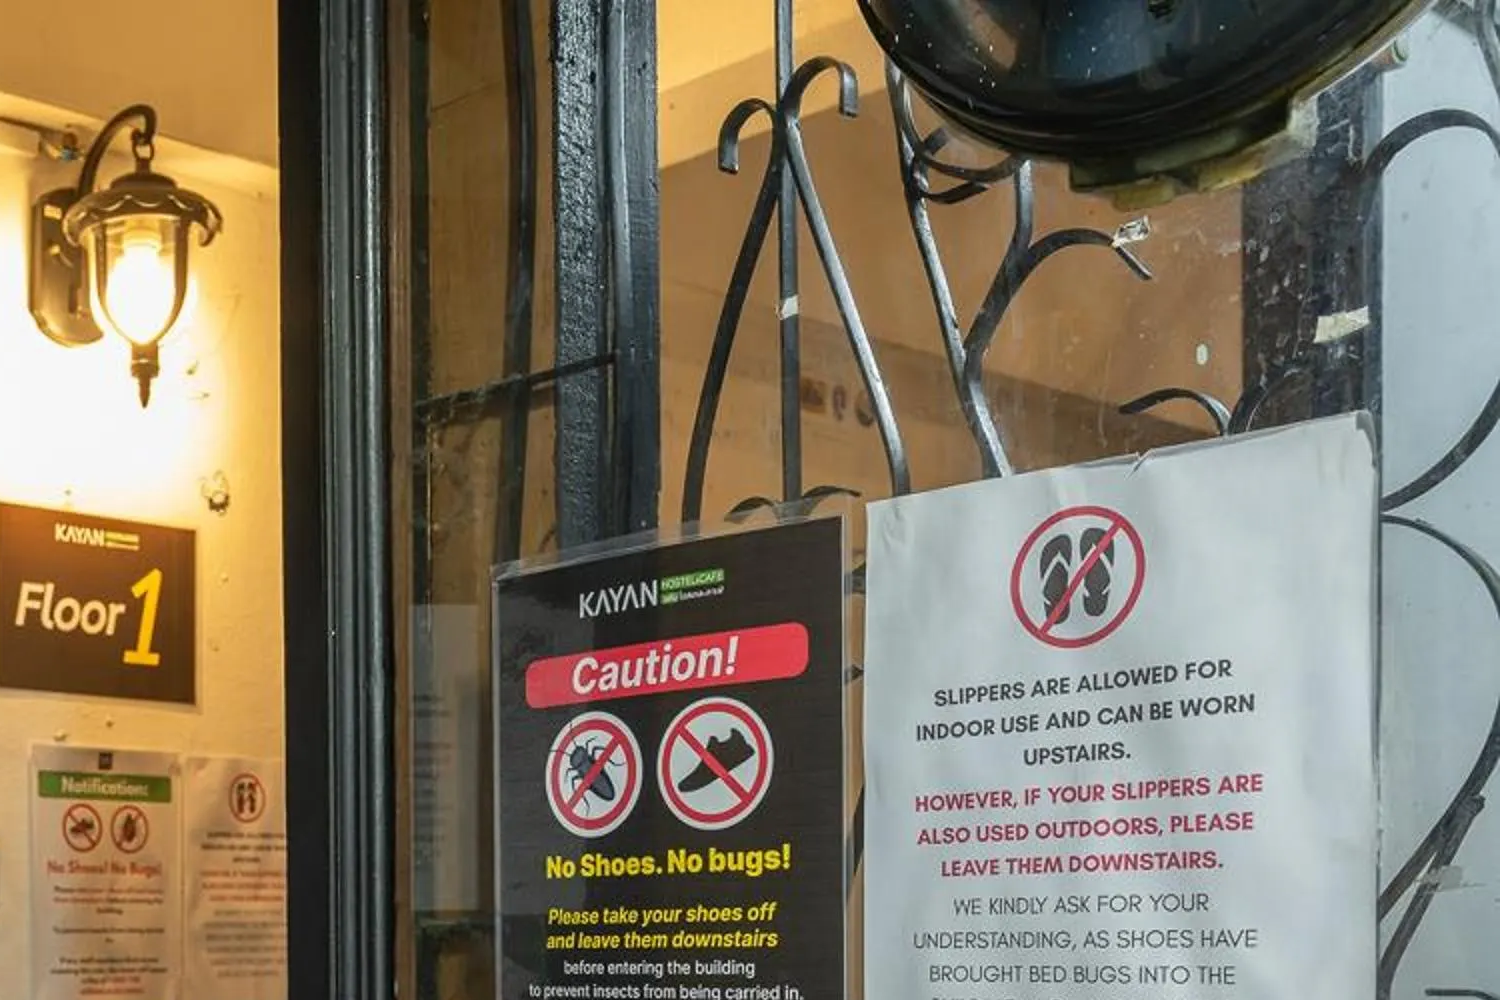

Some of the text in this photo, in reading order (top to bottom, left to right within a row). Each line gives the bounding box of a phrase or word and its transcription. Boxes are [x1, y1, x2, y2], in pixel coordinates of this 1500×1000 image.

[55, 523, 105, 547] KAYAN
[579, 580, 658, 618] KAYAN
[15, 568, 163, 666] Floor 1
[572, 636, 739, 695] Caution!
[934, 659, 1232, 707] SLIPPERS ARE ALLOWED FOR
[916, 694, 1255, 741] INDOOR USE AND CAN BE WORN
[1023, 742, 1131, 766] UPSTAIRS.
[915, 774, 1264, 812] HOWEVER, IF YOUR SLIPPERS ARE
[917, 812, 1254, 845] ALSO USED OUTDOORS, PLEASE
[546, 843, 791, 879] No Shoes. No bugs!
[941, 851, 1224, 877] LEAVE THEM DOWNSTAIRS.
[548, 902, 777, 927] Please take your shoes off
[953, 893, 1209, 916] WE KINDLY ASK FOR YOUR
[547, 929, 778, 949] and leave them downstairs
[913, 929, 1258, 950] UNDERSTANDING, AS SHOES HAVE
[564, 960, 755, 978] before entering the building
[929, 966, 1236, 985] BROUGHT BED BUGS INTO THE
[529, 984, 541, 997] to
[544, 985, 590, 1000] prevent
[593, 984, 640, 999] insects
[643, 984, 676, 1000] from
[725, 985, 780, 1000] carried
[785, 986, 804, 1000] in.
